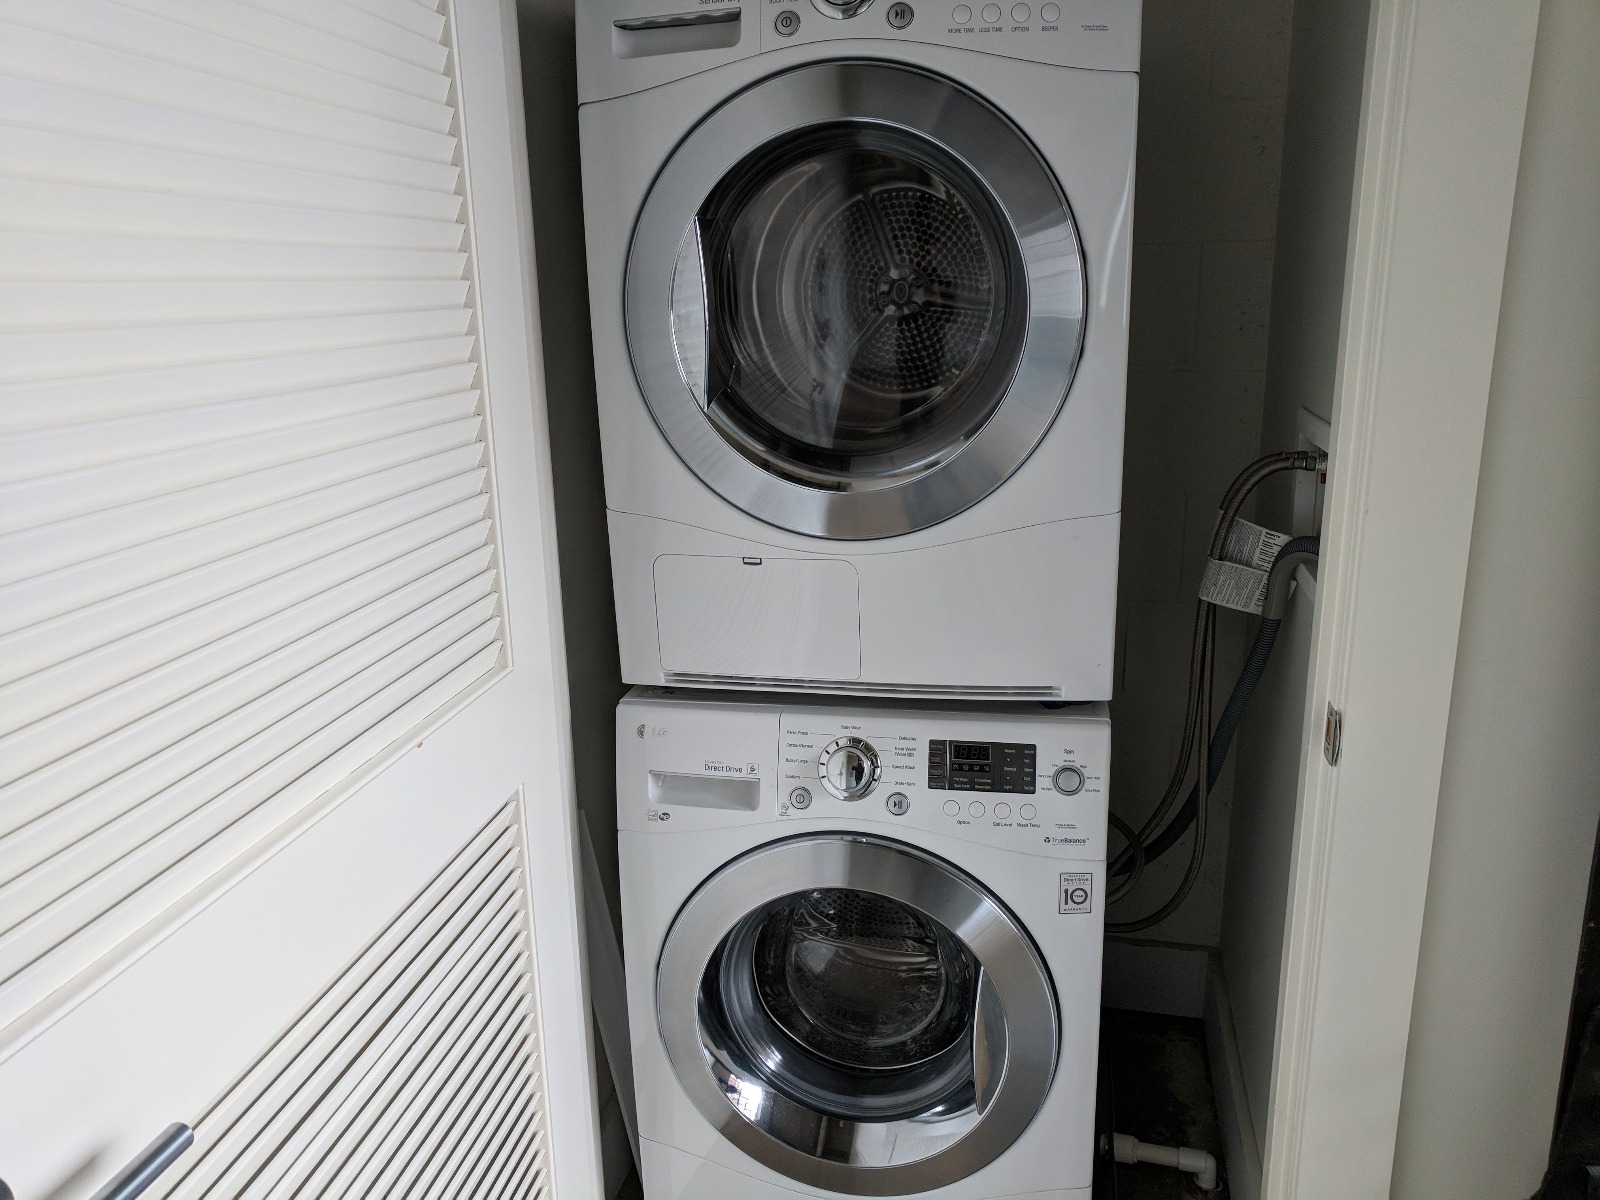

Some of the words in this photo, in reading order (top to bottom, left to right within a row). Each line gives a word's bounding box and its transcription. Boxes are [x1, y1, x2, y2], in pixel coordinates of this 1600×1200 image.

[704, 763, 725, 773] Direct
[725, 765, 743, 774] Drive
[1063, 887, 1089, 906] 10
